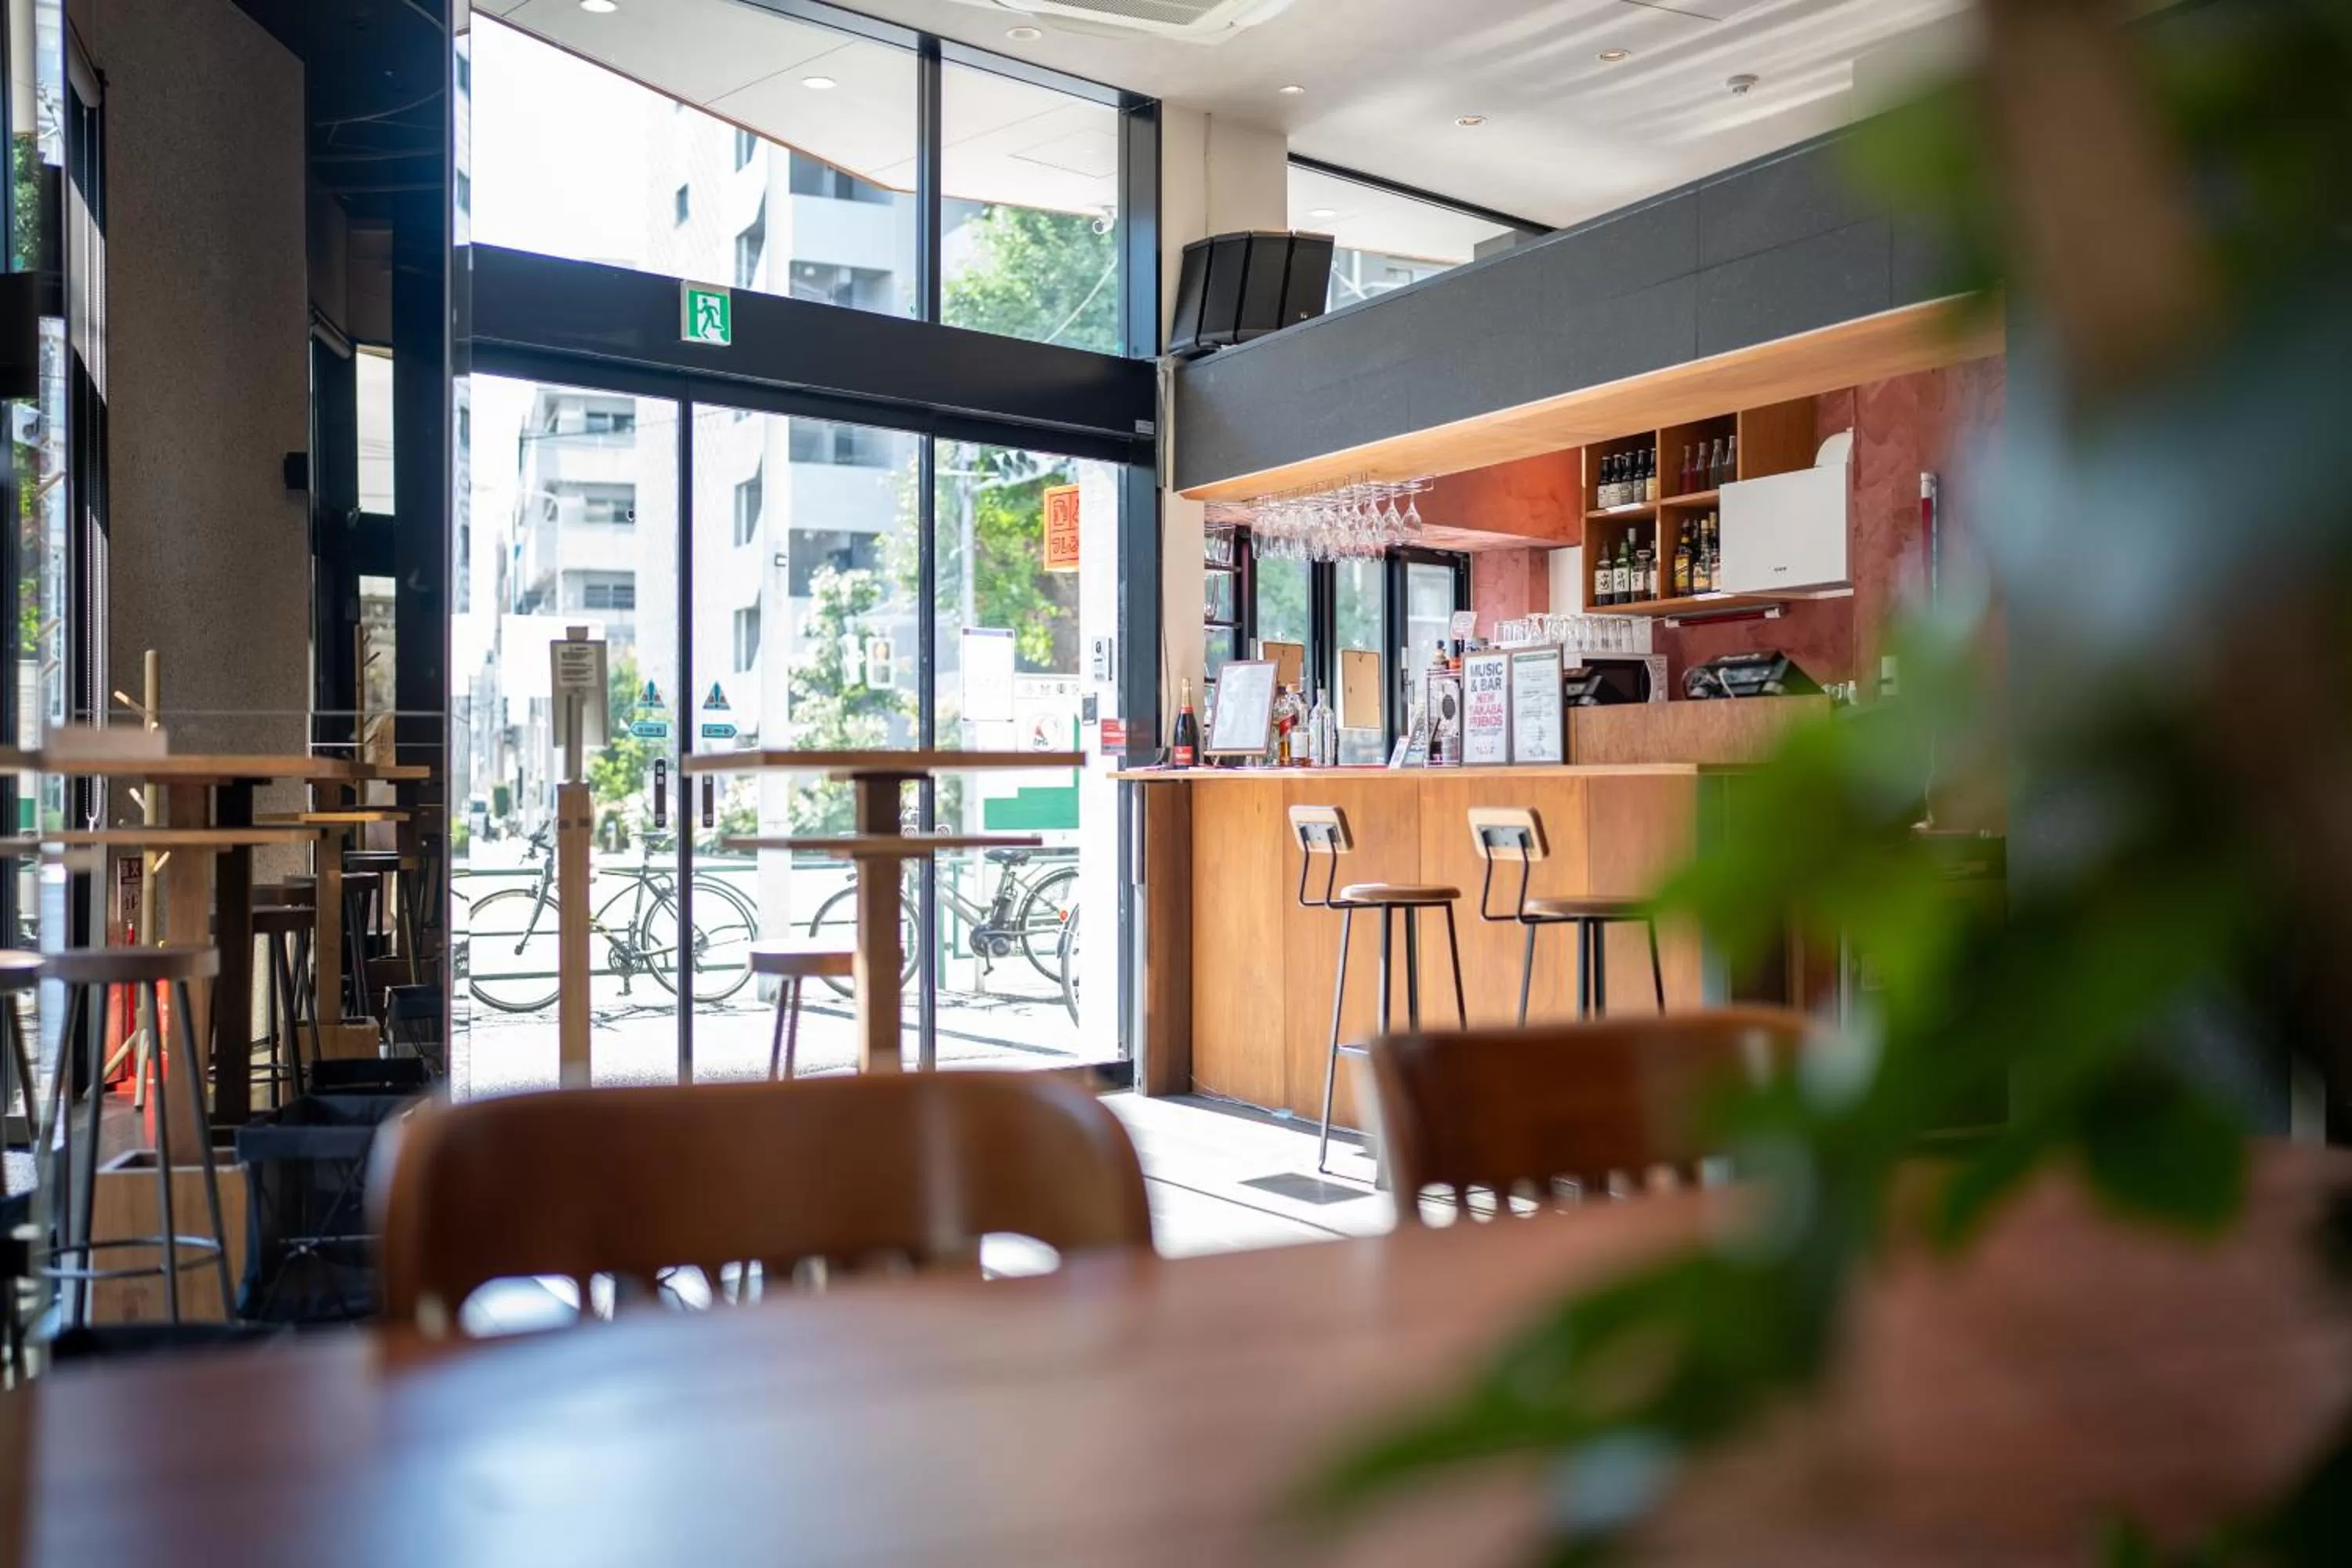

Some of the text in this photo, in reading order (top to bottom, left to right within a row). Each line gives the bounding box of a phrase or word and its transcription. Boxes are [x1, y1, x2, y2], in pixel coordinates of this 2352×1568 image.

[1470, 662, 1503, 677] MUSIC
[1470, 677, 1502, 692] & BAR
